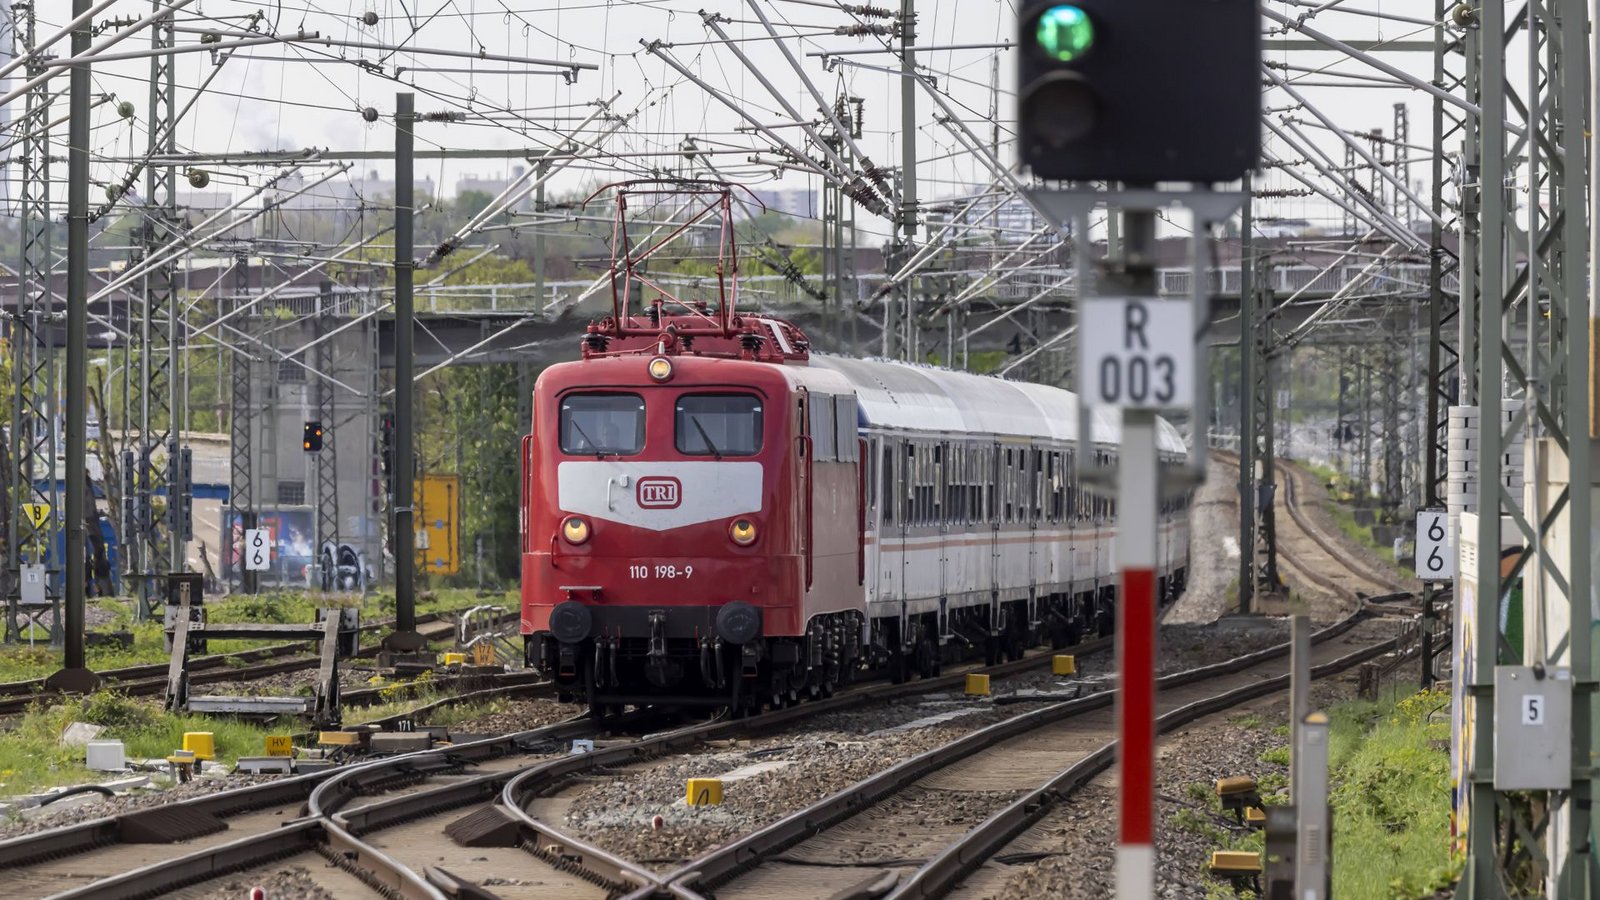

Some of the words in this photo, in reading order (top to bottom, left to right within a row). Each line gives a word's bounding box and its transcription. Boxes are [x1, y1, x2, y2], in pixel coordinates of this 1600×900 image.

[1125, 301, 1149, 350] R
[1100, 355, 1175, 403] 003
[644, 485, 674, 500] TRI
[1428, 516, 1445, 542] 6
[1427, 545, 1443, 571] 6
[629, 565, 648, 578] 110
[654, 565, 693, 578] 198-9
[1529, 699, 1538, 721] 5
[398, 720, 410, 731] 171
[272, 738, 286, 747] HV
